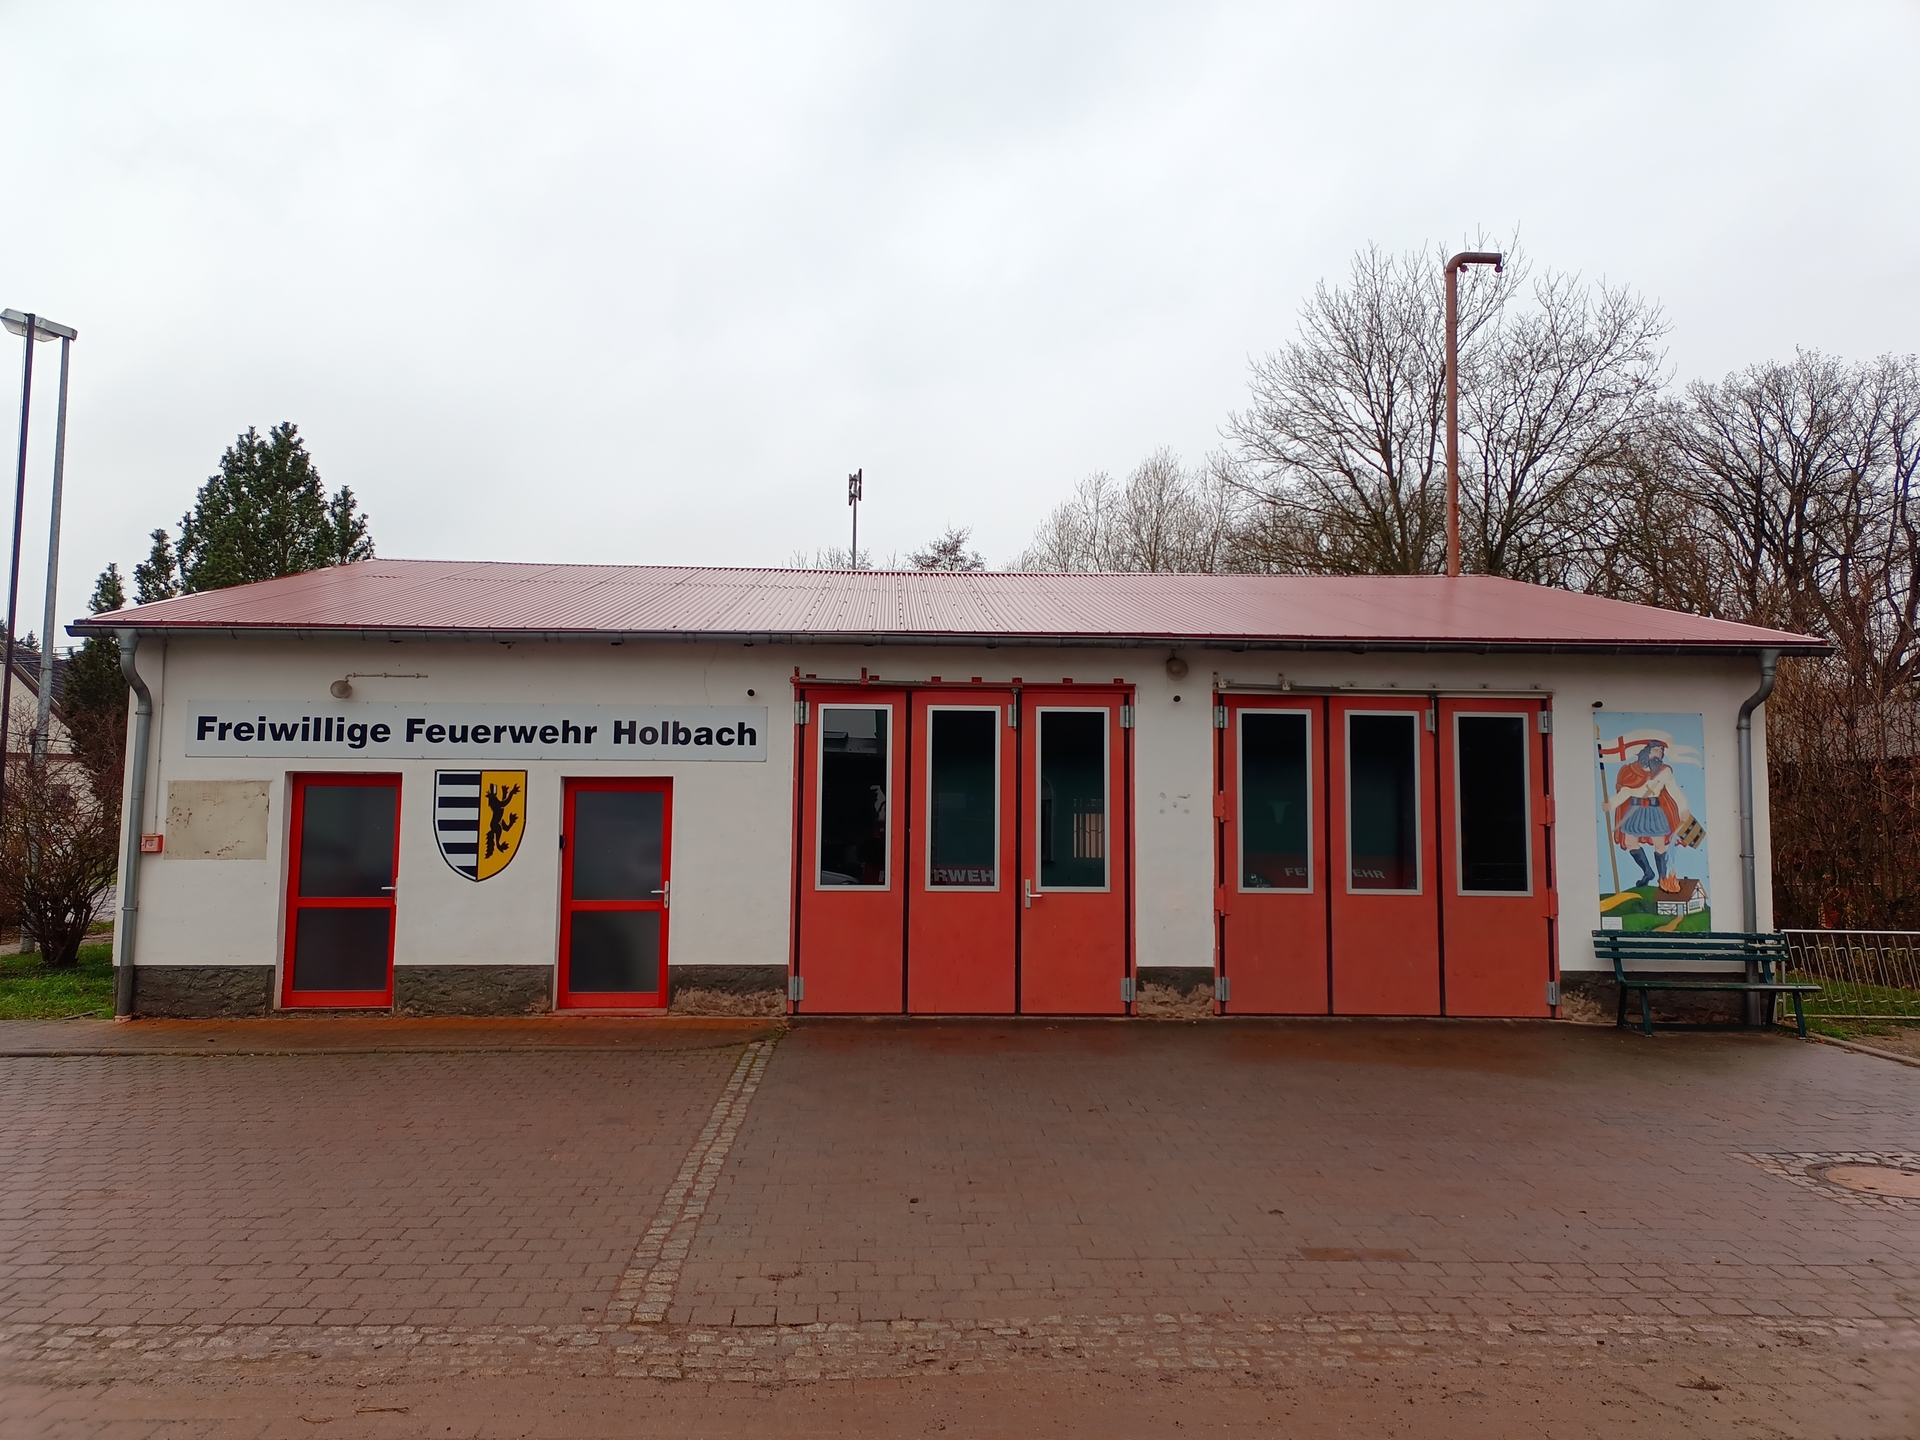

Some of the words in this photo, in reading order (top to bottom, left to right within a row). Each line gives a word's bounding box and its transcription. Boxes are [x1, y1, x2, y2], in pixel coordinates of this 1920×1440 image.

[196, 716, 391, 749] Freiwillige
[405, 718, 598, 745] Feuerwehr
[612, 719, 757, 746] Holbach
